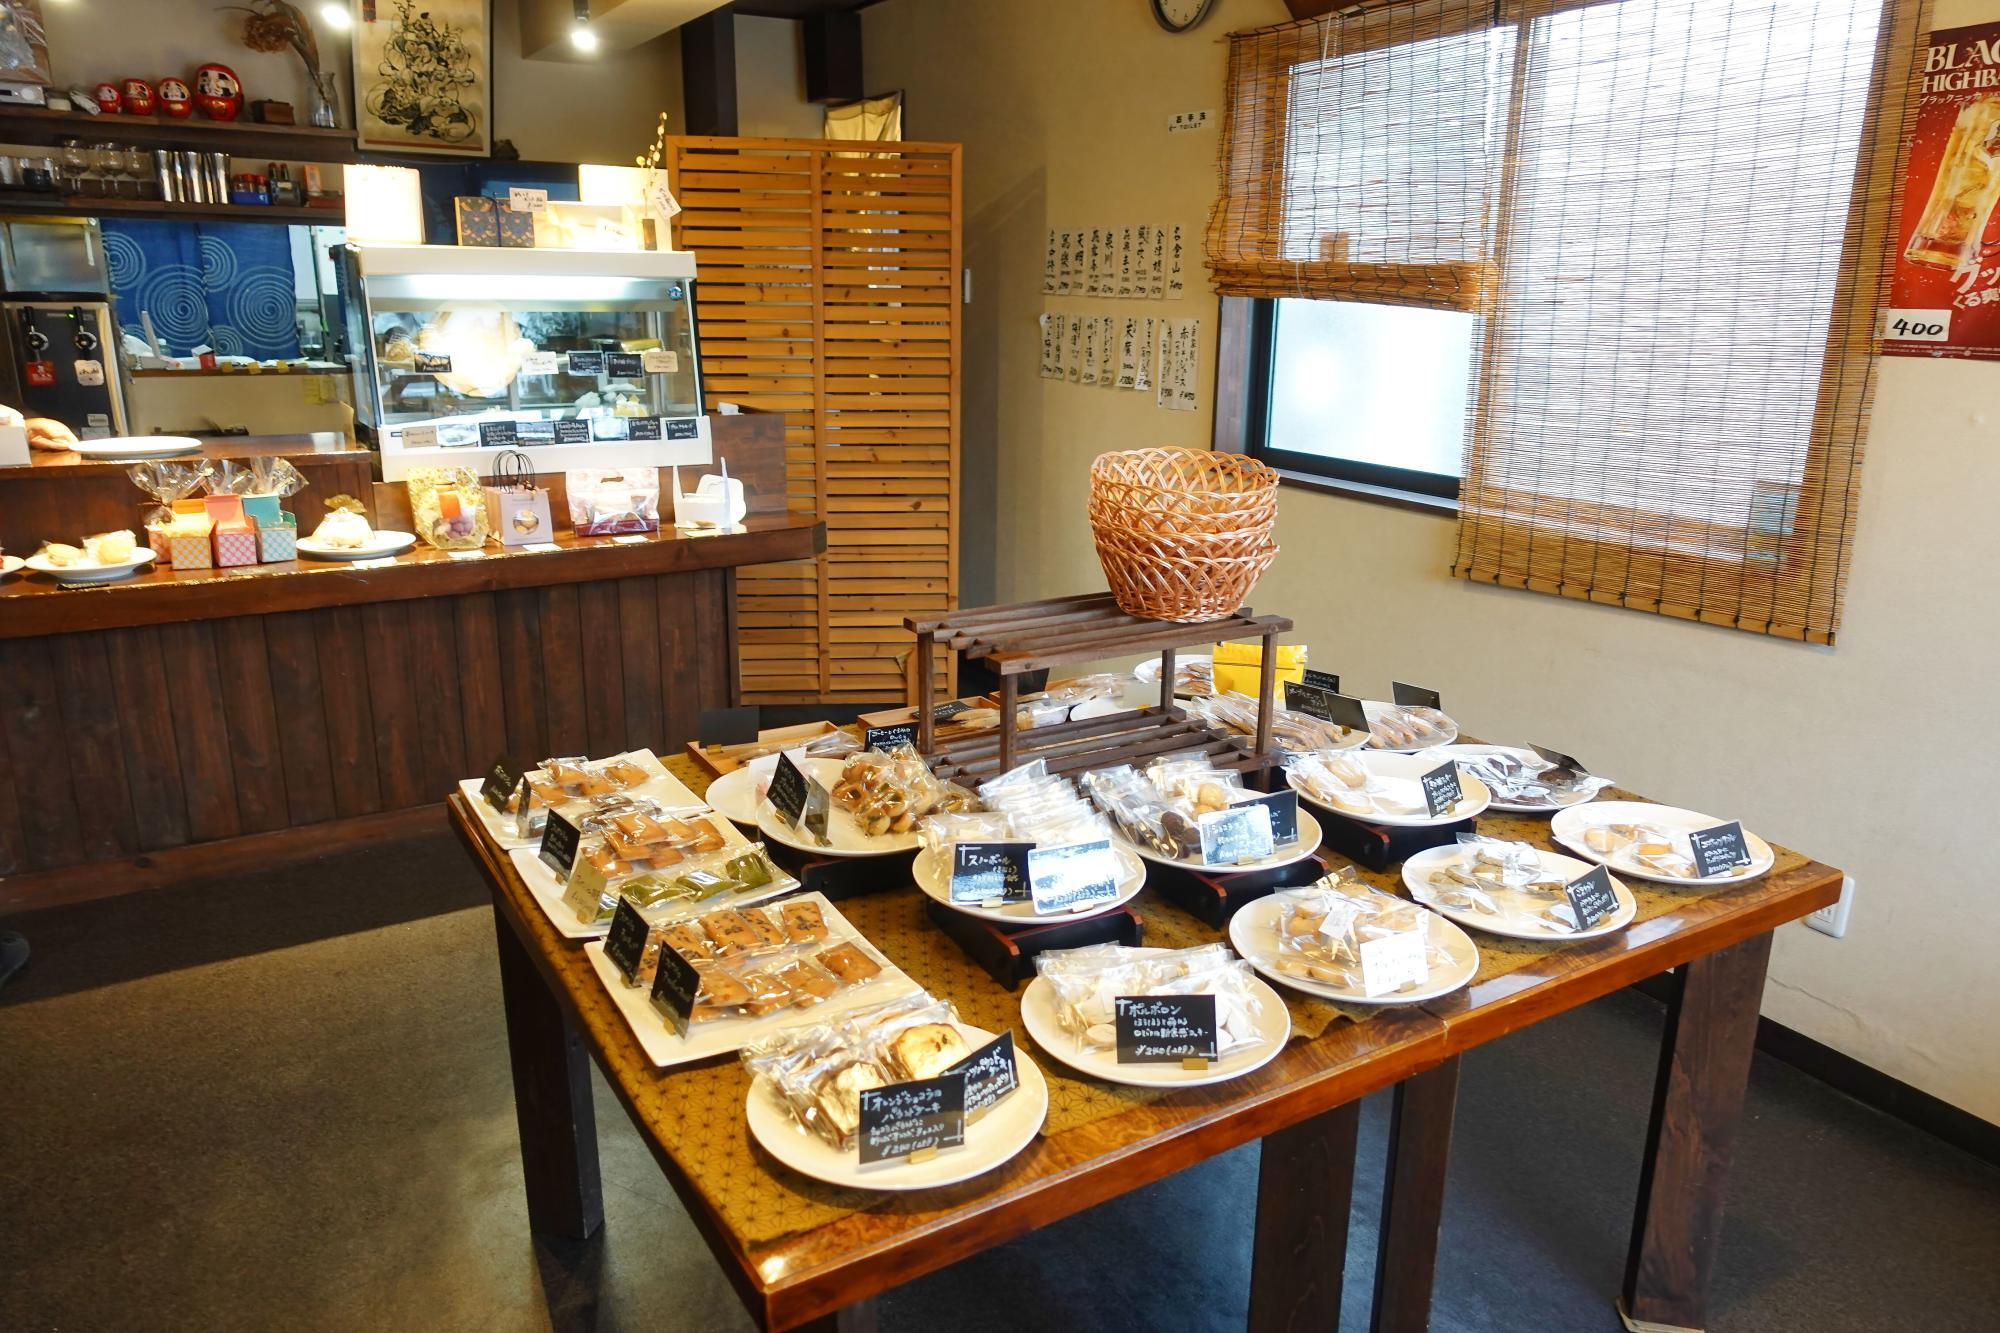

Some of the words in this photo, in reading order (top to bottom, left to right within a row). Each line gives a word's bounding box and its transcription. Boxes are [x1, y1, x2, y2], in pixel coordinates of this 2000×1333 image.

[1920, 68, 2000, 94] HIGHB
[1179, 122, 1202, 130] TOILET
[1952, 287, 2000, 311] くる爽
[1892, 318, 1944, 337] 400
